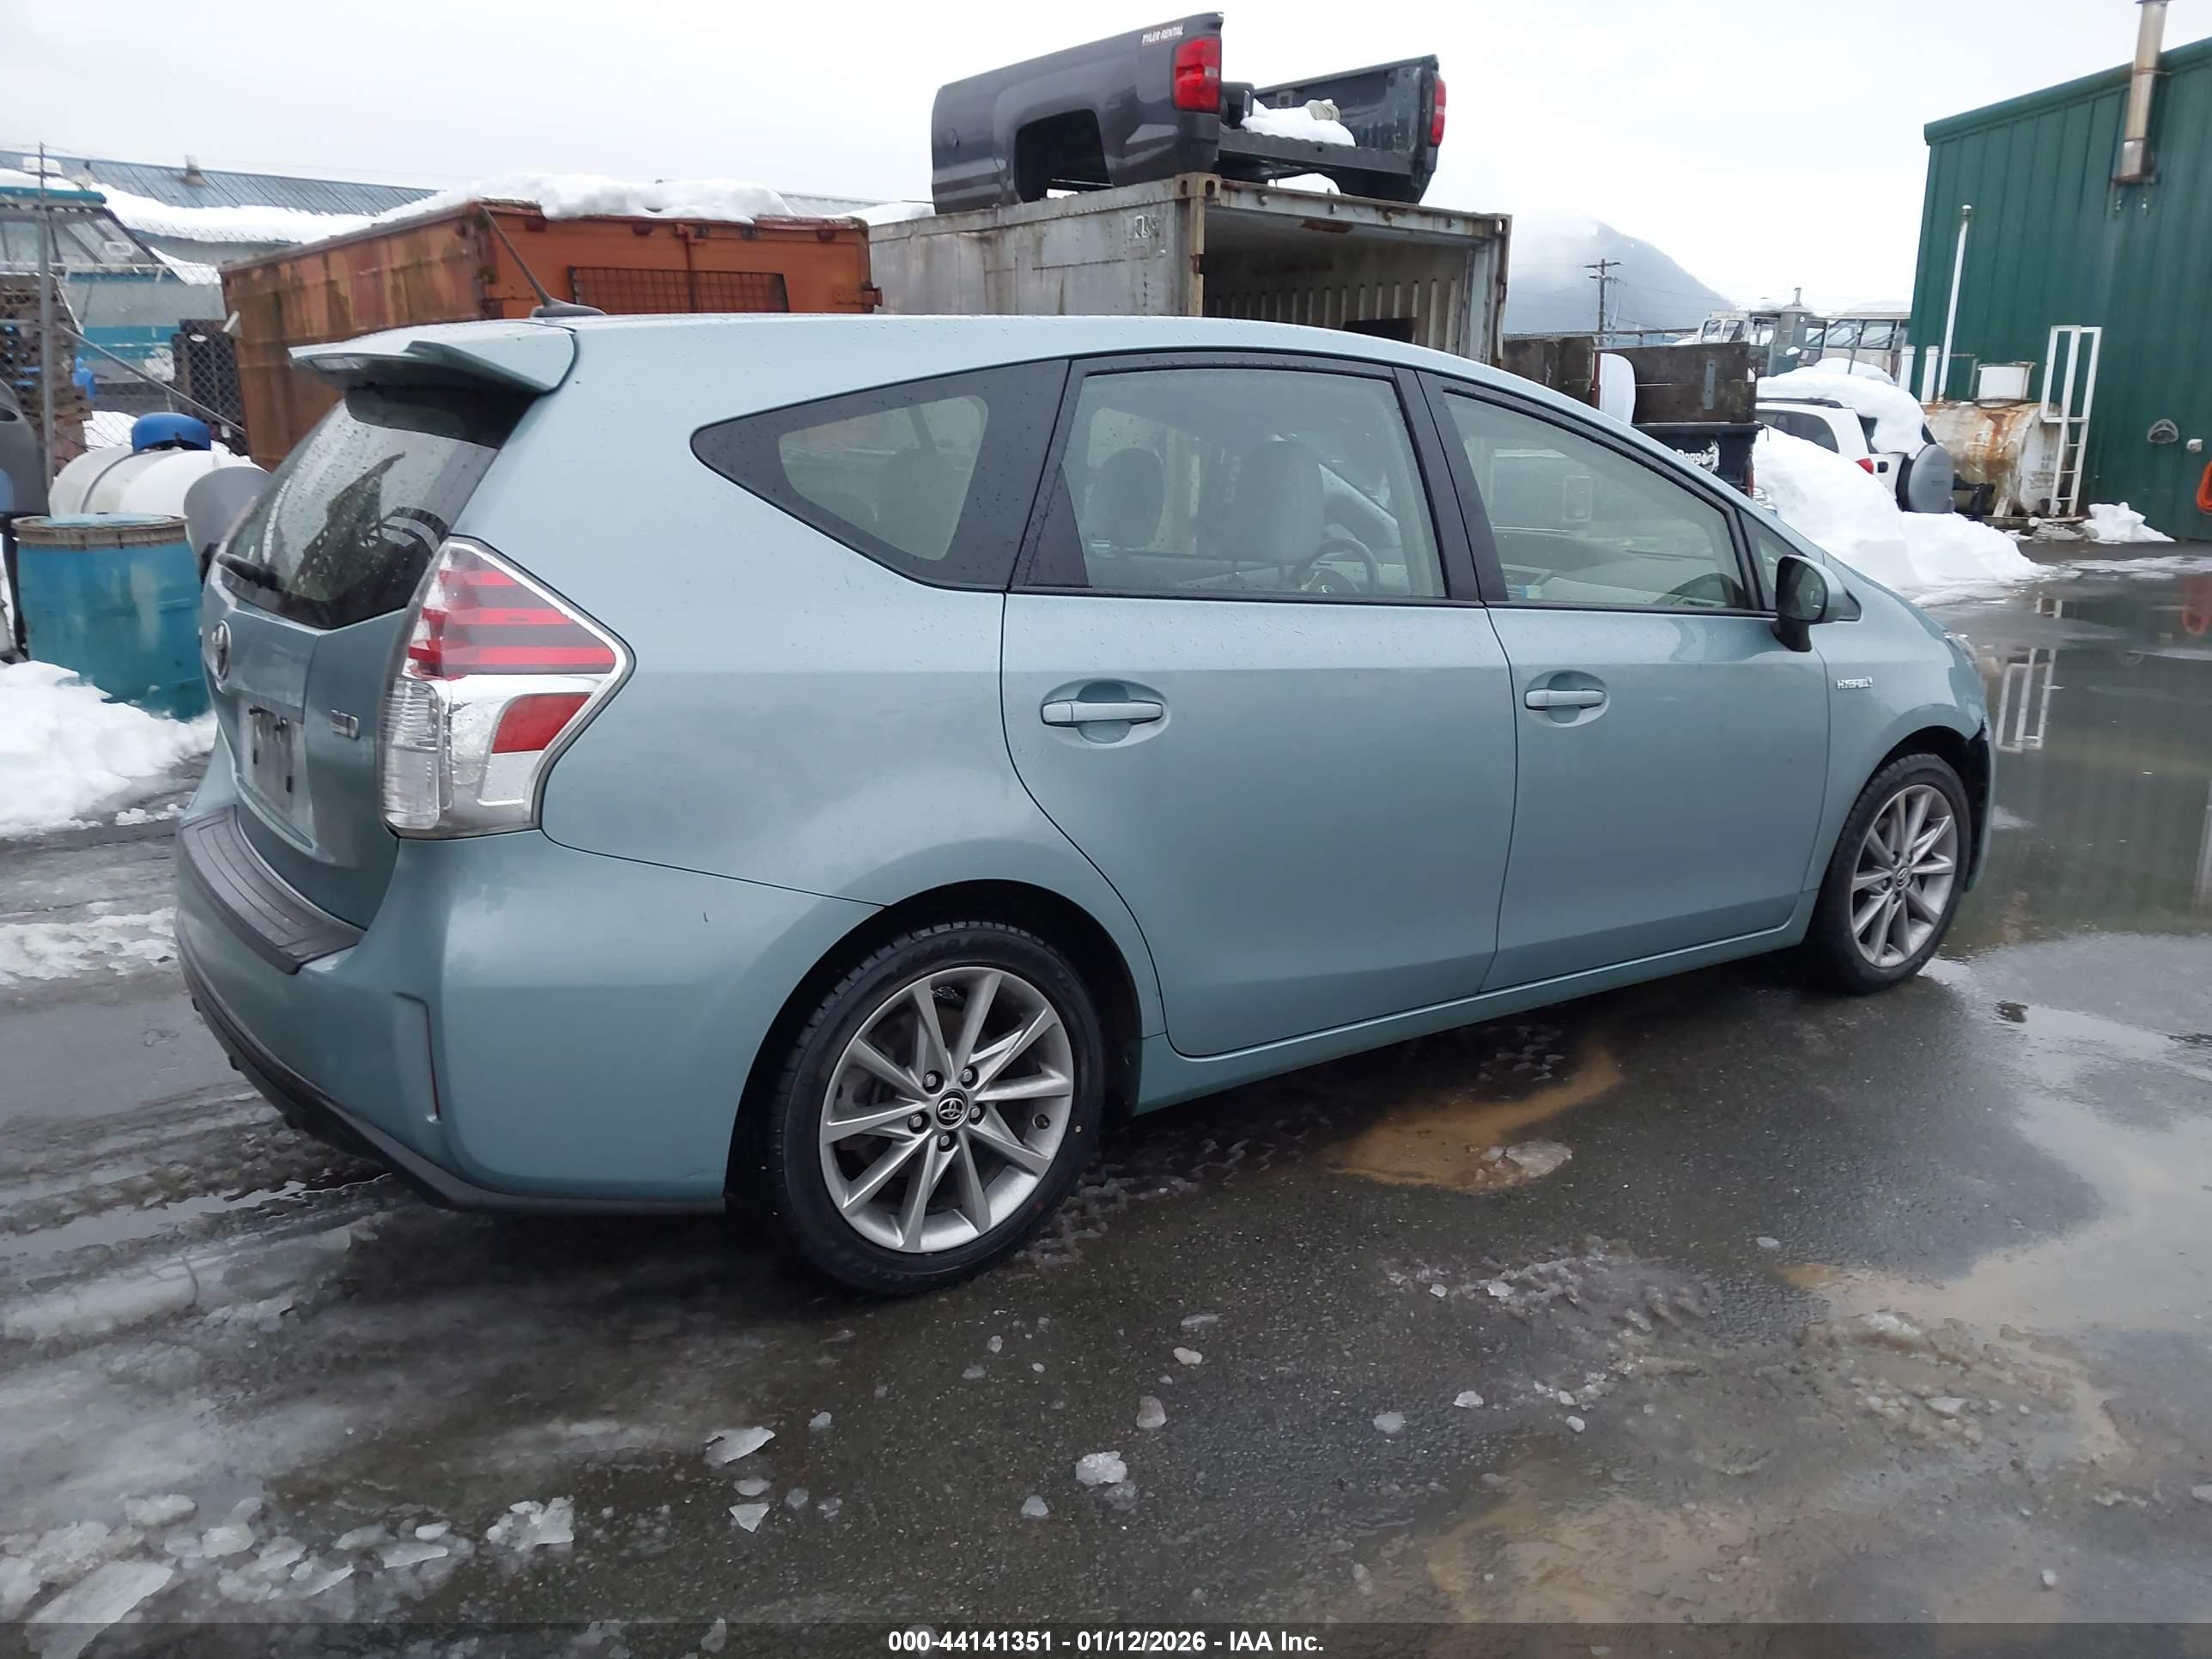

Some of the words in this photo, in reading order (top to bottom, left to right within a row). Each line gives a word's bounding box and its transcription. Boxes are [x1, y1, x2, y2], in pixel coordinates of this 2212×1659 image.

[1141, 30, 1161, 45] TYLER
[1161, 24, 1184, 40] RENTAL
[1836, 678, 1869, 689] HYBRID
